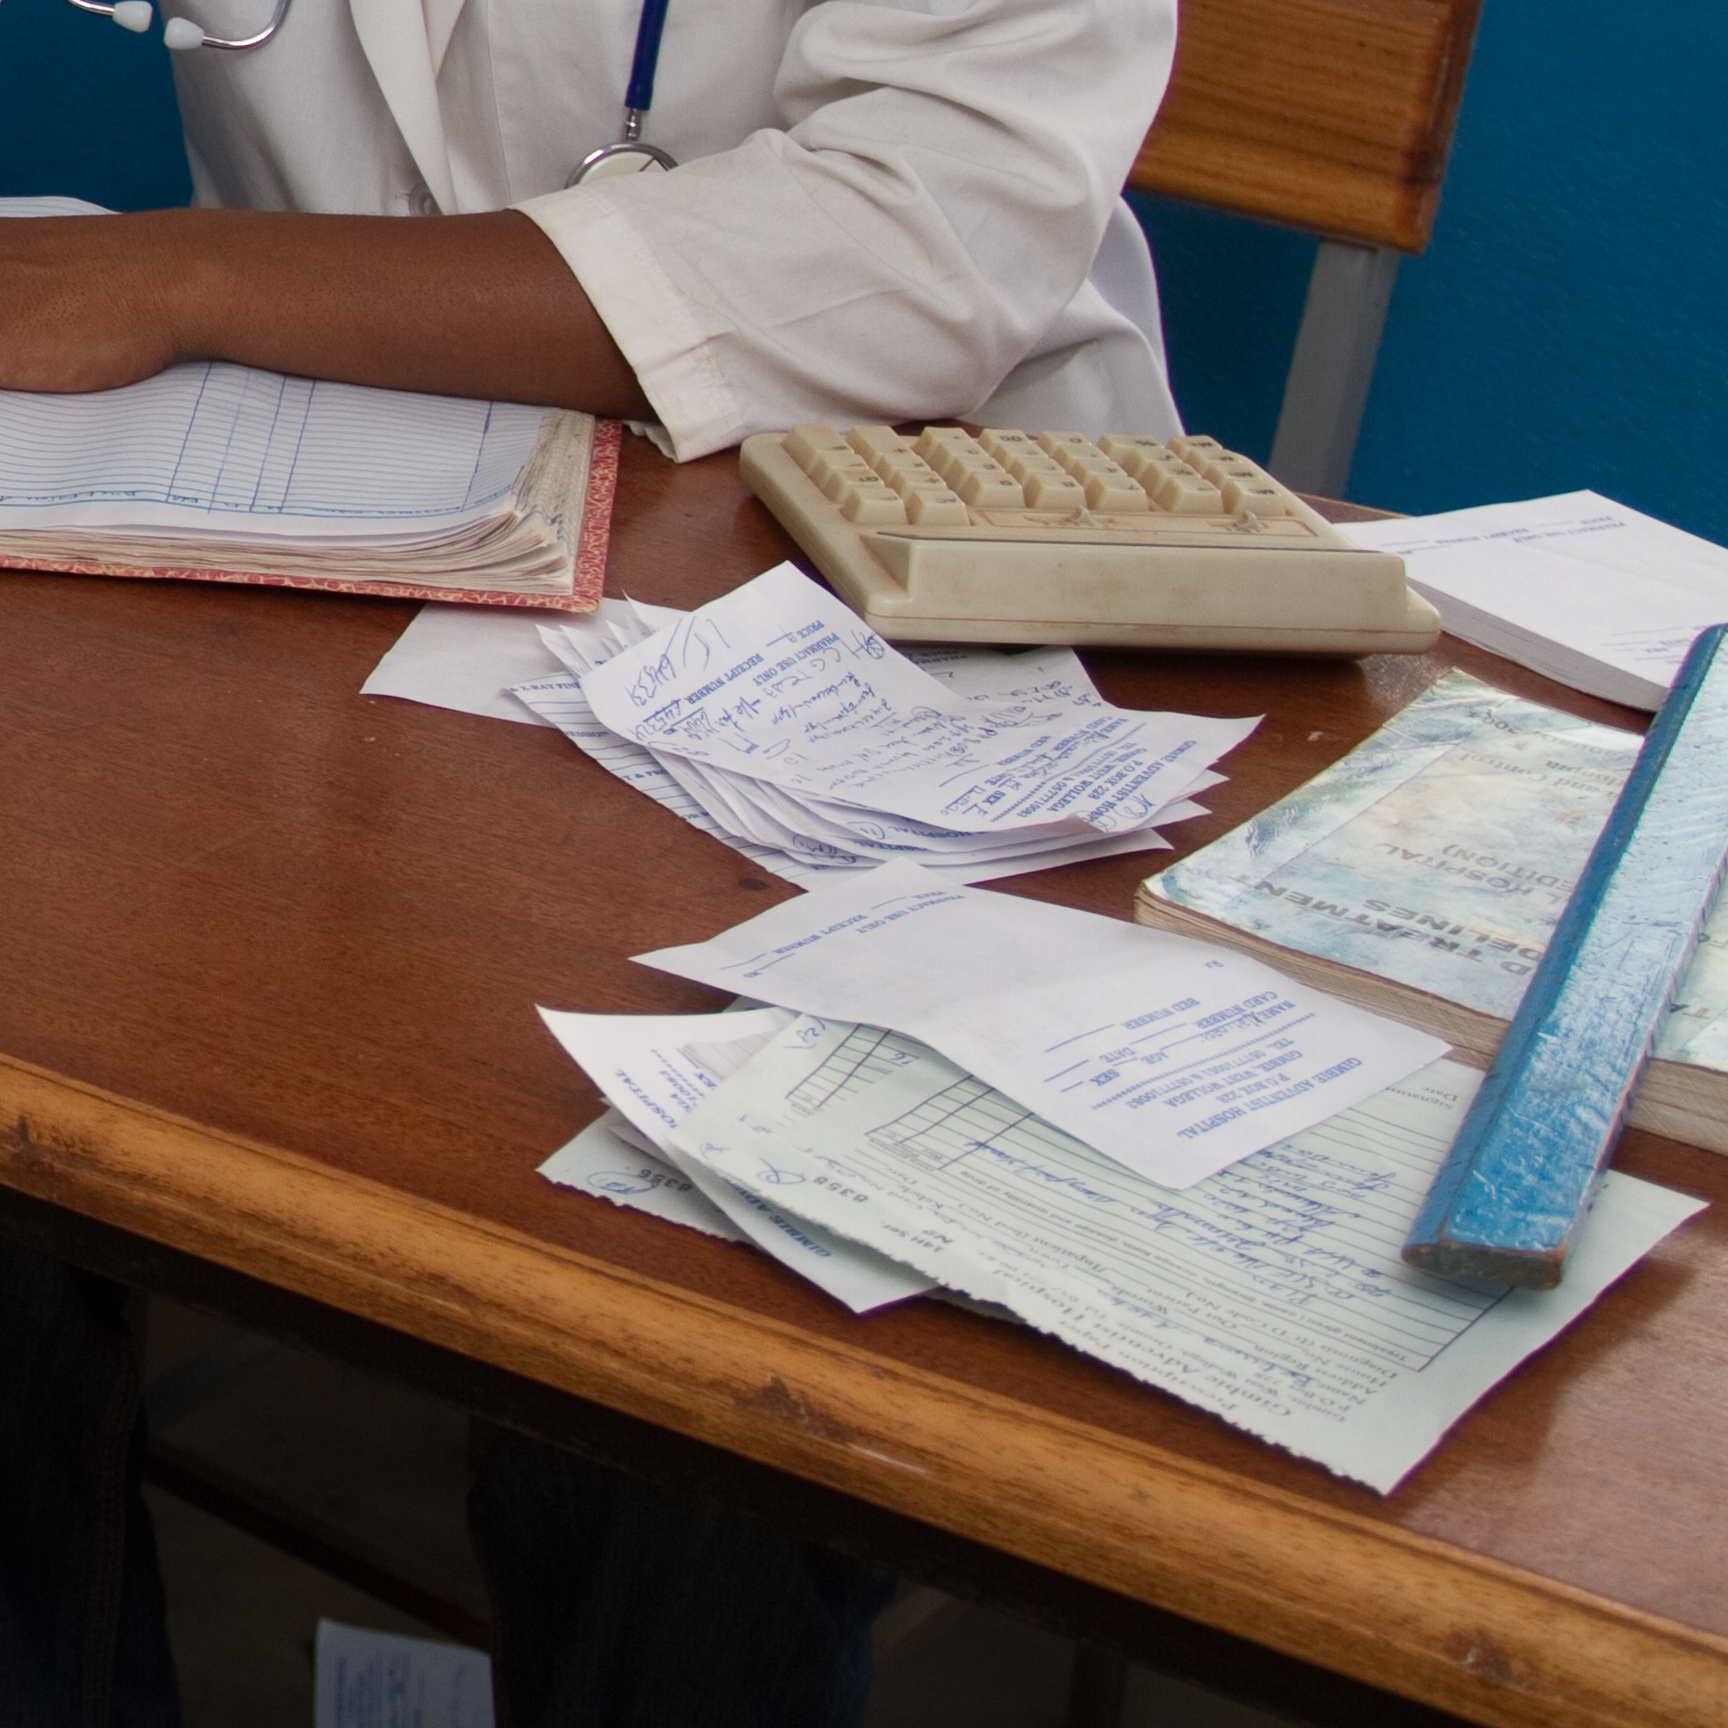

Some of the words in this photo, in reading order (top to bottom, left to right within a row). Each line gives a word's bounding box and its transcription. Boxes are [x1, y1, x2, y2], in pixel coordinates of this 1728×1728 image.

[794, 632, 840, 661] PHARMACY
[724, 653, 764, 682] RECEIPT
[752, 667, 778, 687] ONLY
[775, 656, 796, 672] USE
[684, 677, 726, 705] NUMBER
[1225, 873, 1483, 963] TREATMENT
[1171, 997, 1201, 1012] BED
[1242, 991, 1278, 1009] CARD
[1120, 1007, 1174, 1030] NUMBER
[1193, 1005, 1246, 1029] NUMBER
[1221, 1069, 1258, 1087] WEST
[1311, 1057, 1362, 1085] GIMBIE
[1162, 1080, 1225, 1108] WOLLEGA
[1244, 1080, 1315, 1112] ADVENTIST
[1176, 1106, 1246, 1140] HOSPITAL
[813, 1176, 869, 1203] 8358
